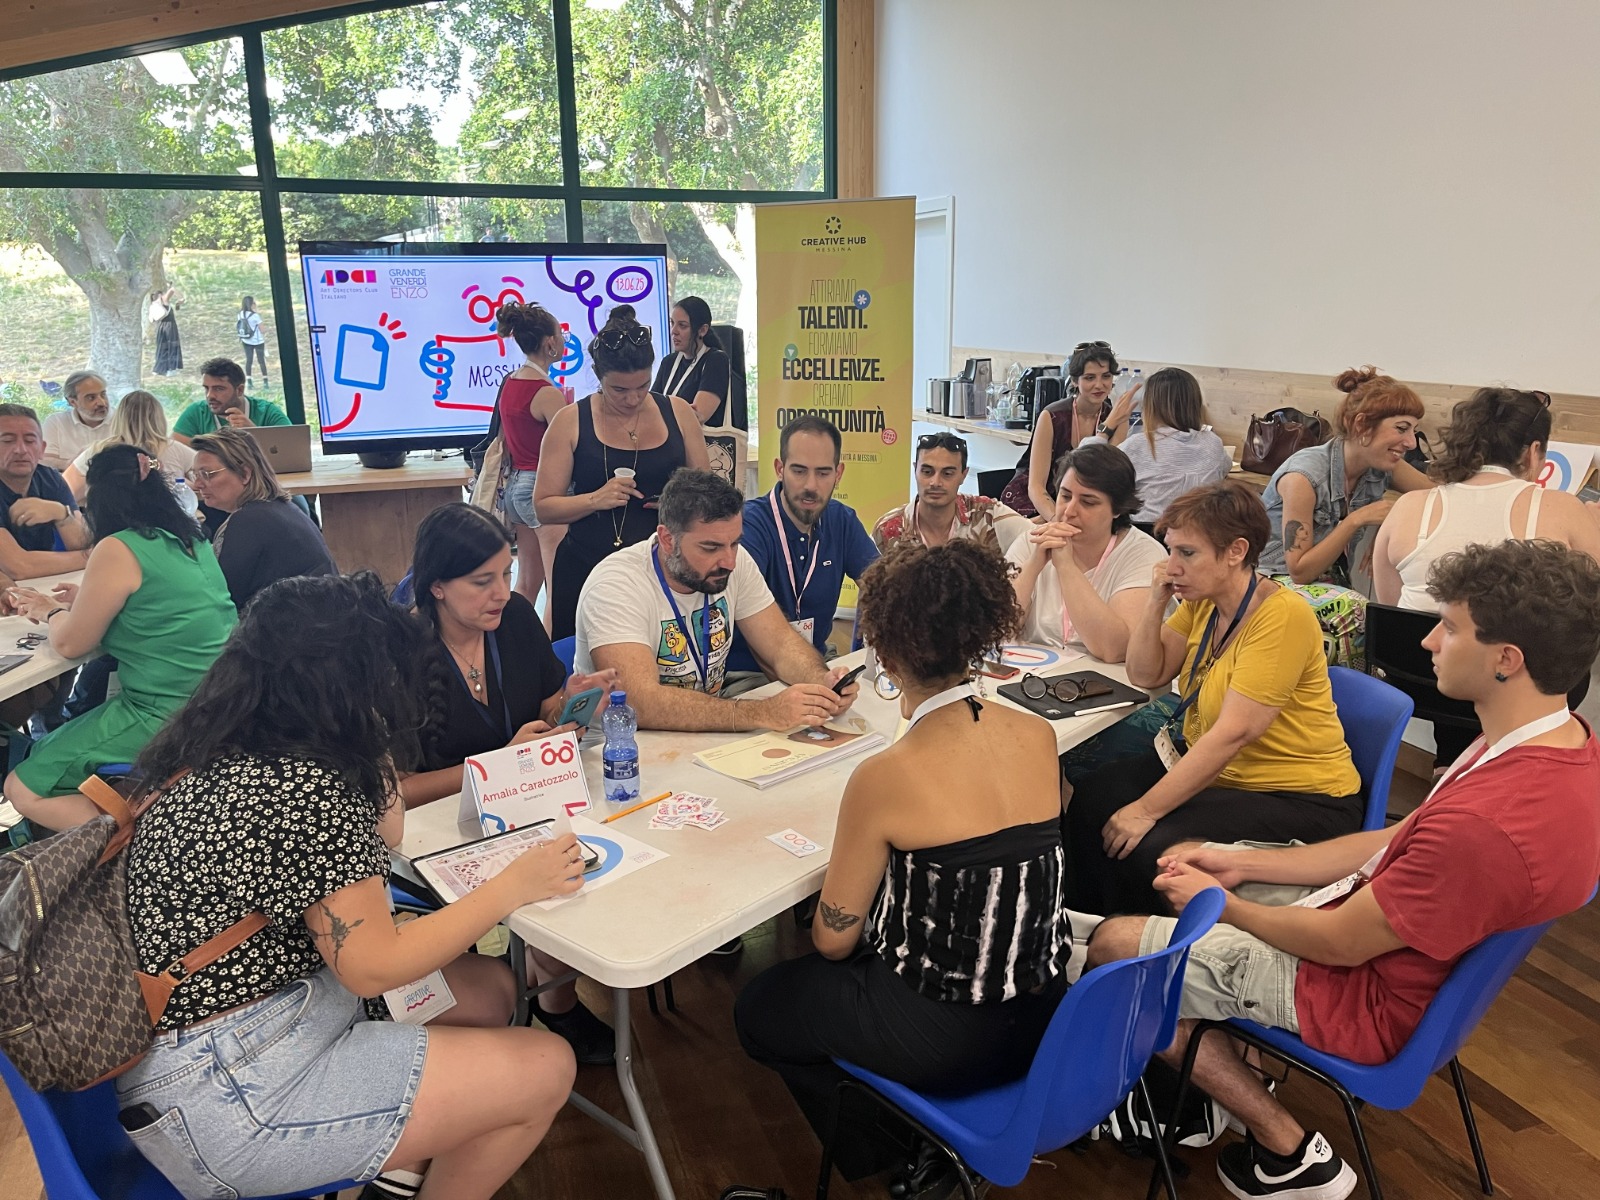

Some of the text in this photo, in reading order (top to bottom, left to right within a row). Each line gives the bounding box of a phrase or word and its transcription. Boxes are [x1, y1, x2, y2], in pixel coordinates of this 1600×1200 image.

[801, 236, 867, 246] CREATIVE HUB
[389, 268, 426, 277] GRANDE
[389, 276, 427, 286] VENERDÌ
[615, 277, 645, 291] 13.06.25
[390, 287, 429, 299] ENZO
[809, 278, 857, 303] ATTIRIAMO
[797, 305, 868, 329] TALENTI.
[808, 331, 858, 356] FORMIAMO
[782, 357, 885, 382] ECCELLENZE.
[812, 383, 853, 407] CREIAMO
[482, 770, 579, 803] Amalia Caratozzolo
